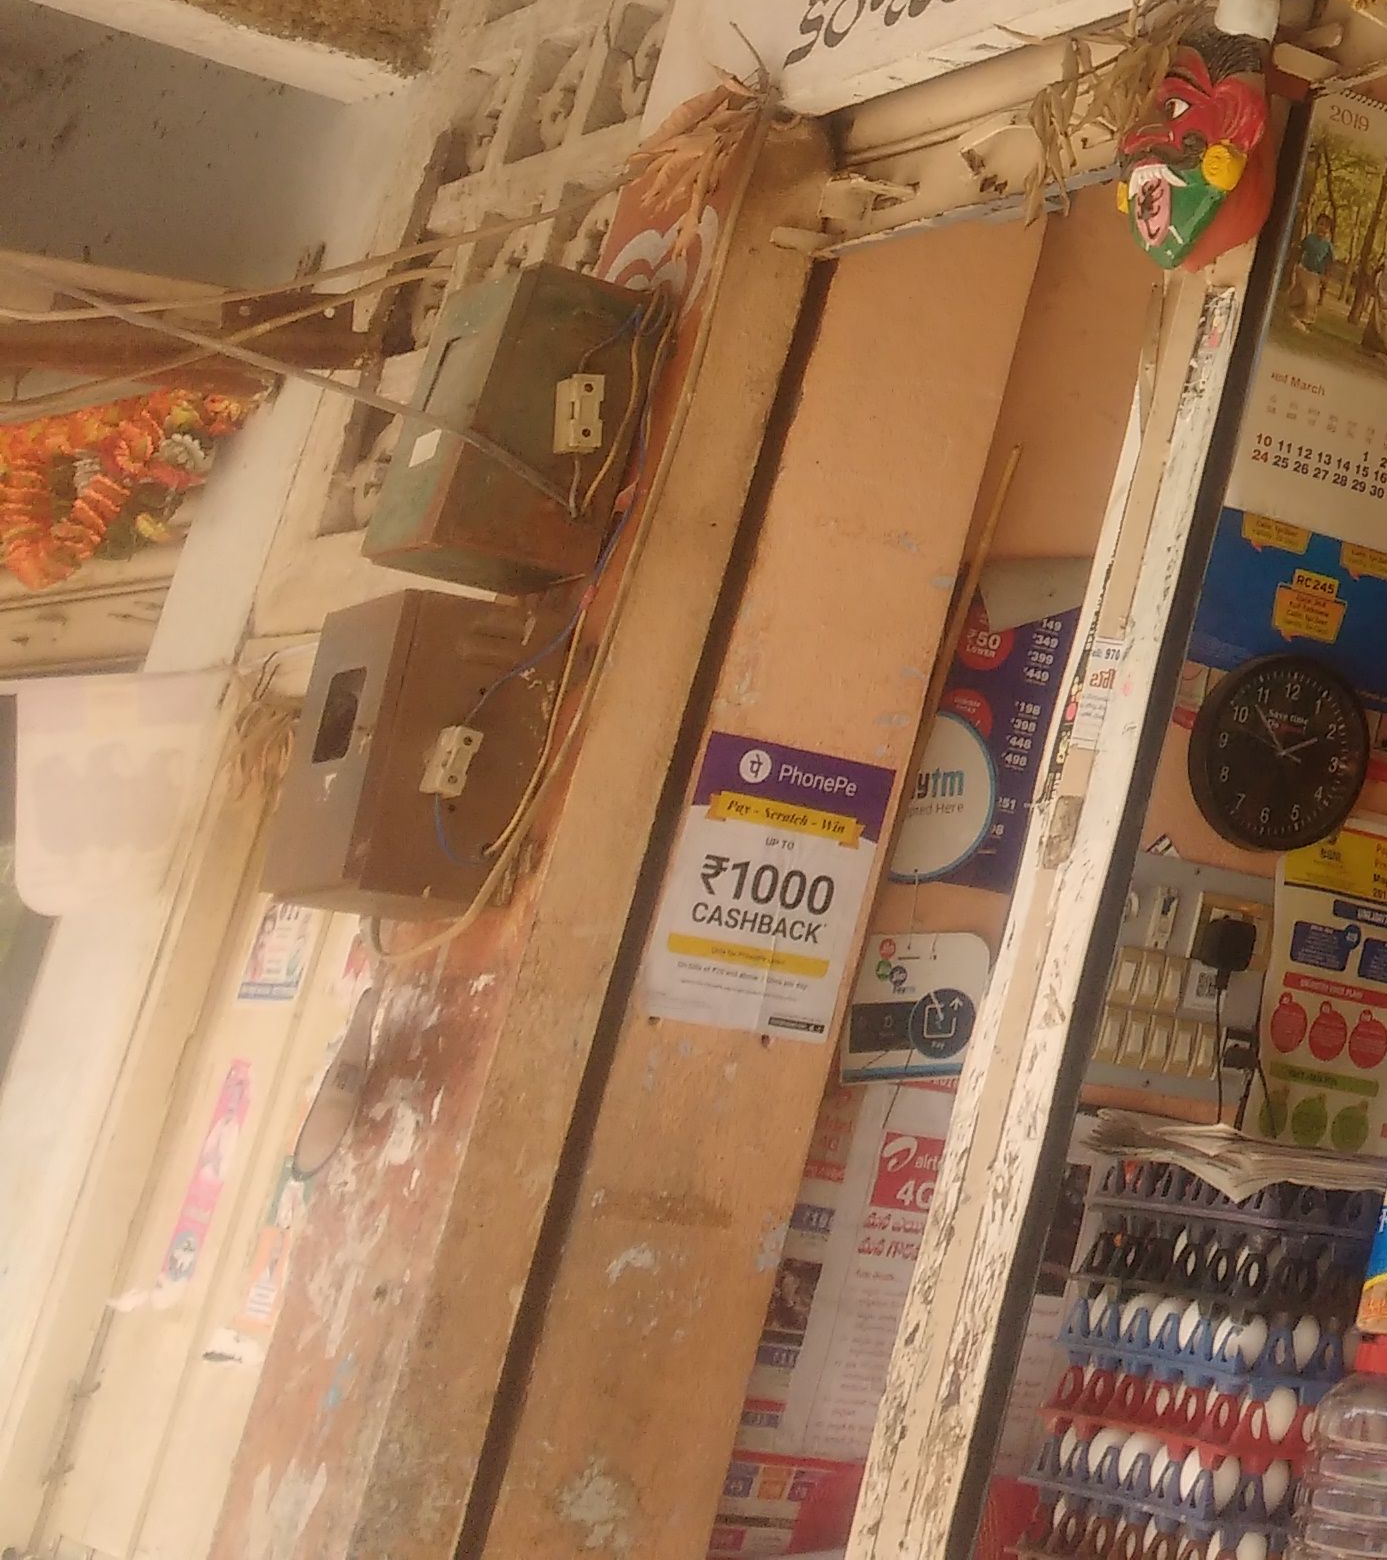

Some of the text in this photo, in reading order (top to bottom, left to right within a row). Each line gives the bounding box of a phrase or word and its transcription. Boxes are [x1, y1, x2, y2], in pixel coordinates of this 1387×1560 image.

[1329, 103, 1370, 132] 2019
[1256, 434, 1273, 447] 10
[1277, 440, 1293, 453] 11
[1297, 446, 1313, 460] 12
[1317, 452, 1332, 465] 13
[1337, 458, 1351, 472] 14
[1355, 464, 1370, 478] 15
[1373, 470, 1387, 484] 16
[1363, 451, 1369, 462] 1
[1380, 457, 1387, 468] 2
[1252, 450, 1269, 463] 24
[1272, 455, 1289, 469] 25
[1293, 461, 1309, 475] 26
[1312, 467, 1329, 480] 27
[1332, 472, 1348, 486] 28
[1351, 479, 1366, 492] 29
[1369, 485, 1385, 499] 30
[1257, 687, 1270, 704] 11
[1286, 683, 1300, 701] 12
[1233, 705, 1248, 723] 10
[1315, 698, 1323, 715] 1
[1219, 732, 1229, 748] 9
[1326, 724, 1337, 740] 2
[1328, 757, 1338, 773] 3
[778, 763, 858, 798] PhonePe
[1220, 766, 1230, 782] 8
[1232, 793, 1246, 810] 7
[1314, 786, 1323, 801] 4
[1260, 807, 1270, 824] 6
[1290, 804, 1300, 821] 5
[765, 836, 795, 850] UP TO
[700, 853, 835, 916] ₹1000
